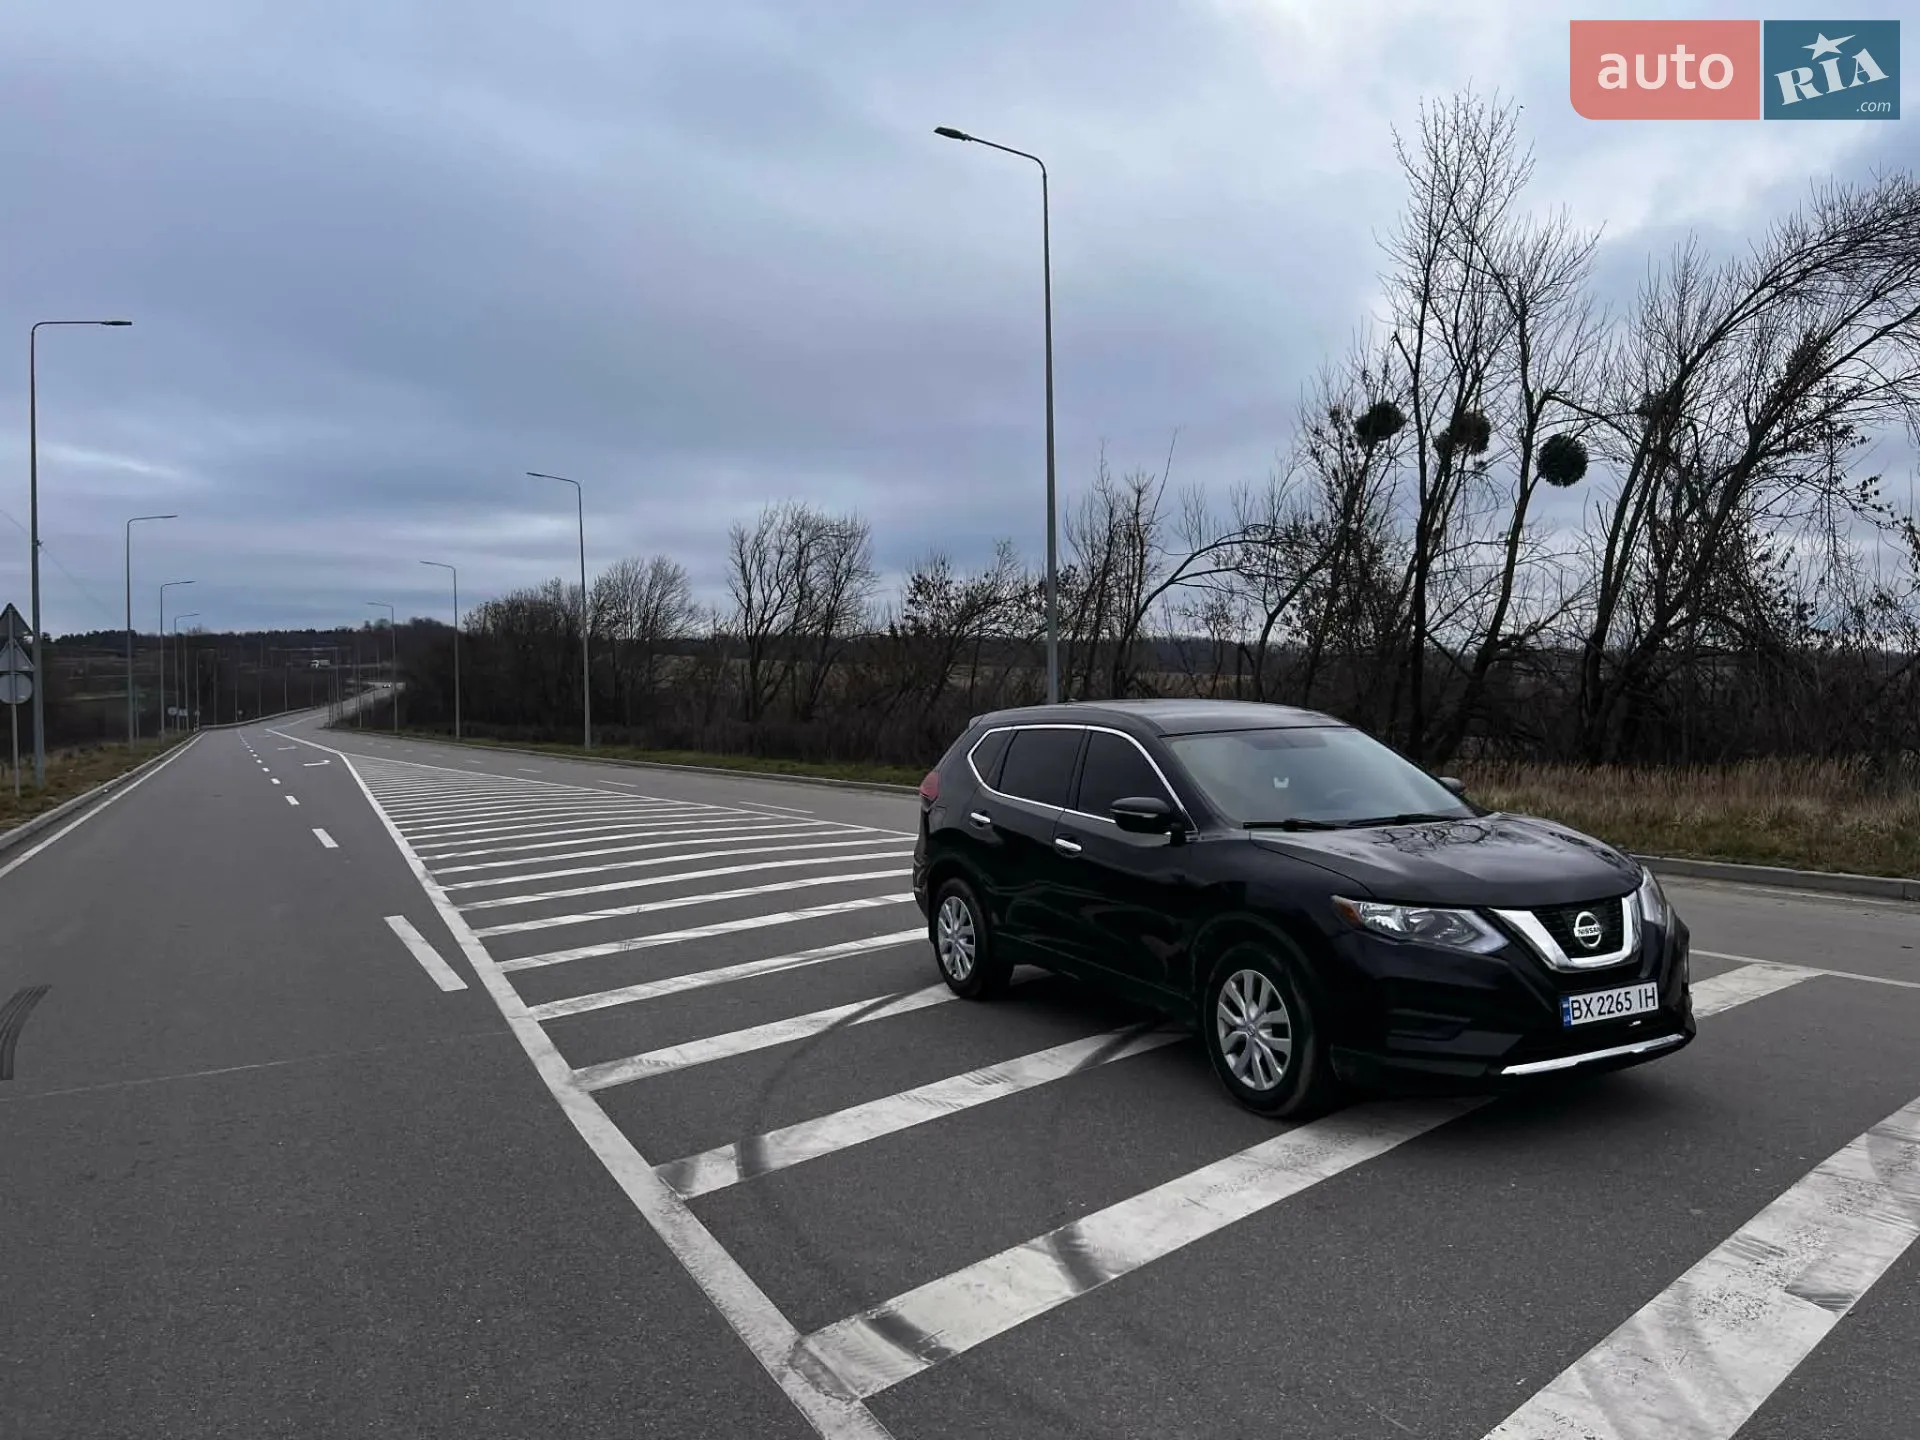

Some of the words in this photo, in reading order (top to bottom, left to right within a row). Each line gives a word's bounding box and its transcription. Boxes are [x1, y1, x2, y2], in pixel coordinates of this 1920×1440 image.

[1571, 997, 1594, 1020] BX
[1597, 991, 1632, 1016] 2265
[1638, 987, 1656, 1009] IH
